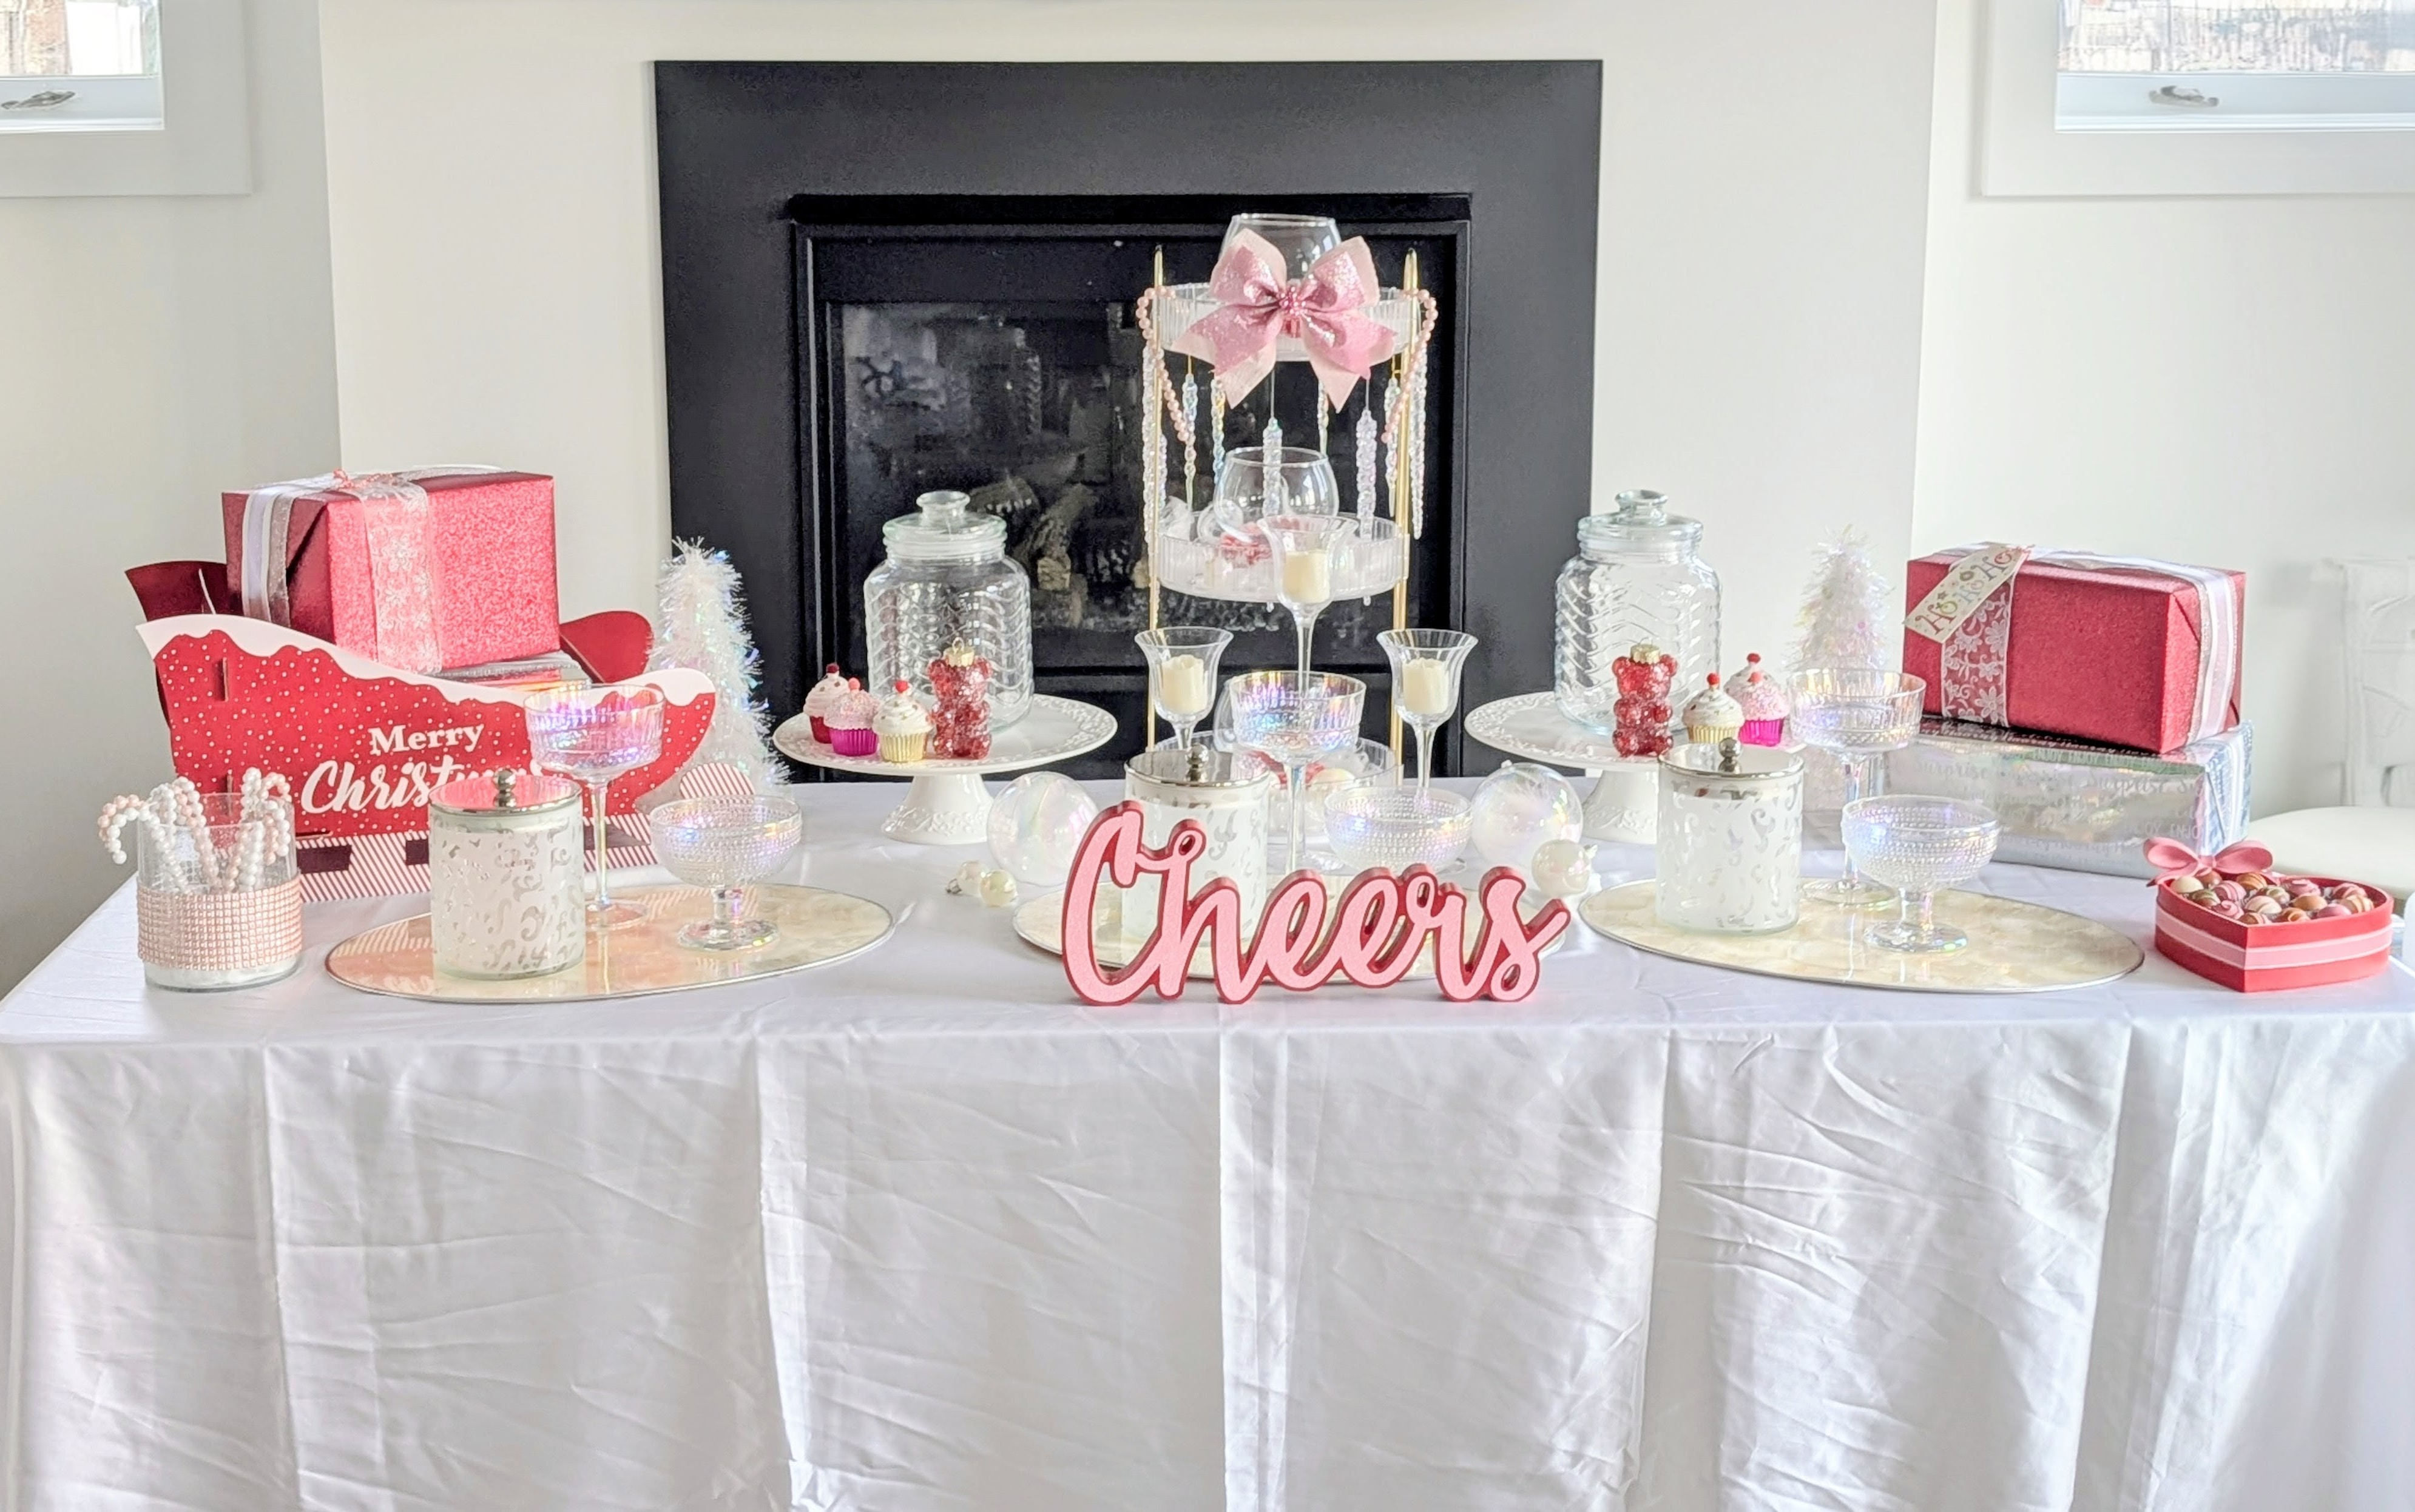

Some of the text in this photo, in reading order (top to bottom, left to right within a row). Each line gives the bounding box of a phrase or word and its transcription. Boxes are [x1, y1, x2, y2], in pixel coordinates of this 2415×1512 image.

[368, 724, 484, 755] Merry
[300, 754, 544, 814] Christ
[1062, 800, 1570, 1006] Cheers
